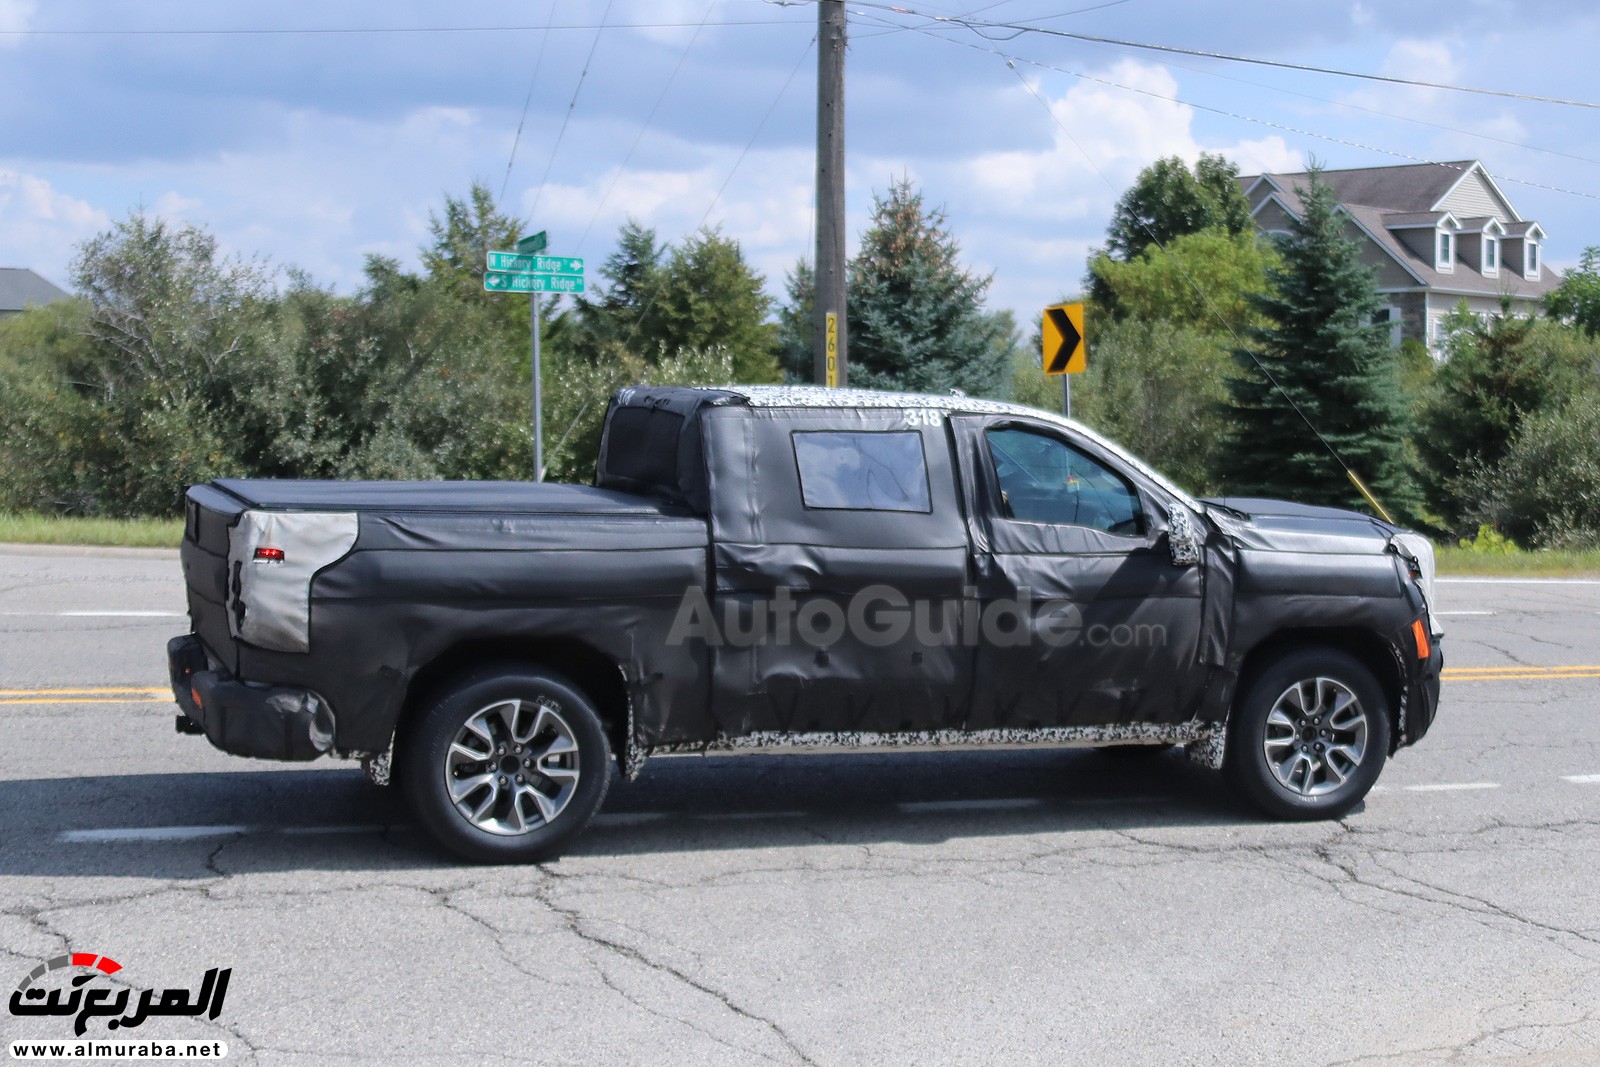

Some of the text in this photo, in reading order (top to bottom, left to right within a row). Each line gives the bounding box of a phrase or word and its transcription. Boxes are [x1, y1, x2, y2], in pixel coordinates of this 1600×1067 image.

[490, 254, 497, 267] N
[501, 255, 532, 271] Hickory
[537, 257, 562, 274] Ridge
[501, 275, 507, 288] S
[512, 275, 546, 291] Hickory
[551, 277, 576, 292] Ridge
[827, 317, 836, 388] 2601
[903, 409, 942, 427] 318
